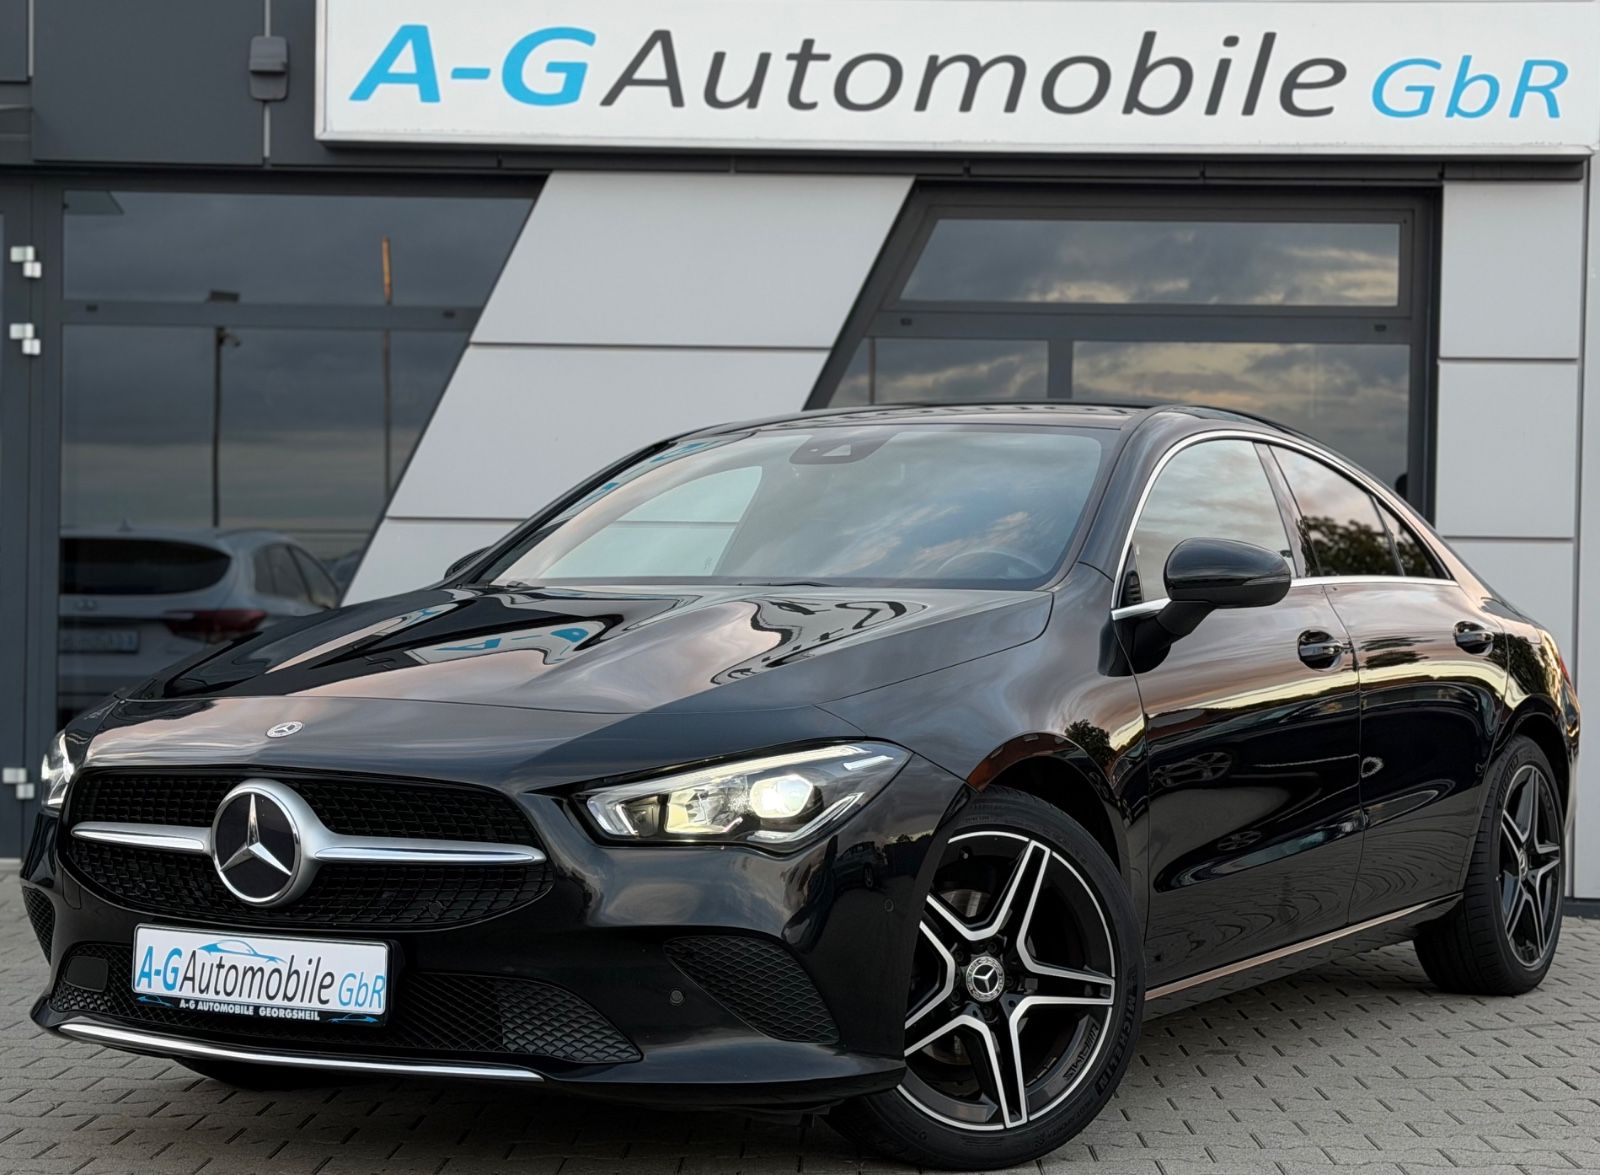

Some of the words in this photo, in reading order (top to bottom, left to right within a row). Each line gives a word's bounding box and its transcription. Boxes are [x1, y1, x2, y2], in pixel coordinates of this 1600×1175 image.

[1371, 54, 1569, 119] GbR
[179, 999, 196, 1010] A-G
[196, 1001, 255, 1016] AUTOMOBILE
[258, 1006, 321, 1021] GEORGSHEIL
[338, 971, 386, 1009] GbR
[1097, 993, 1137, 1090] MICHELIN
